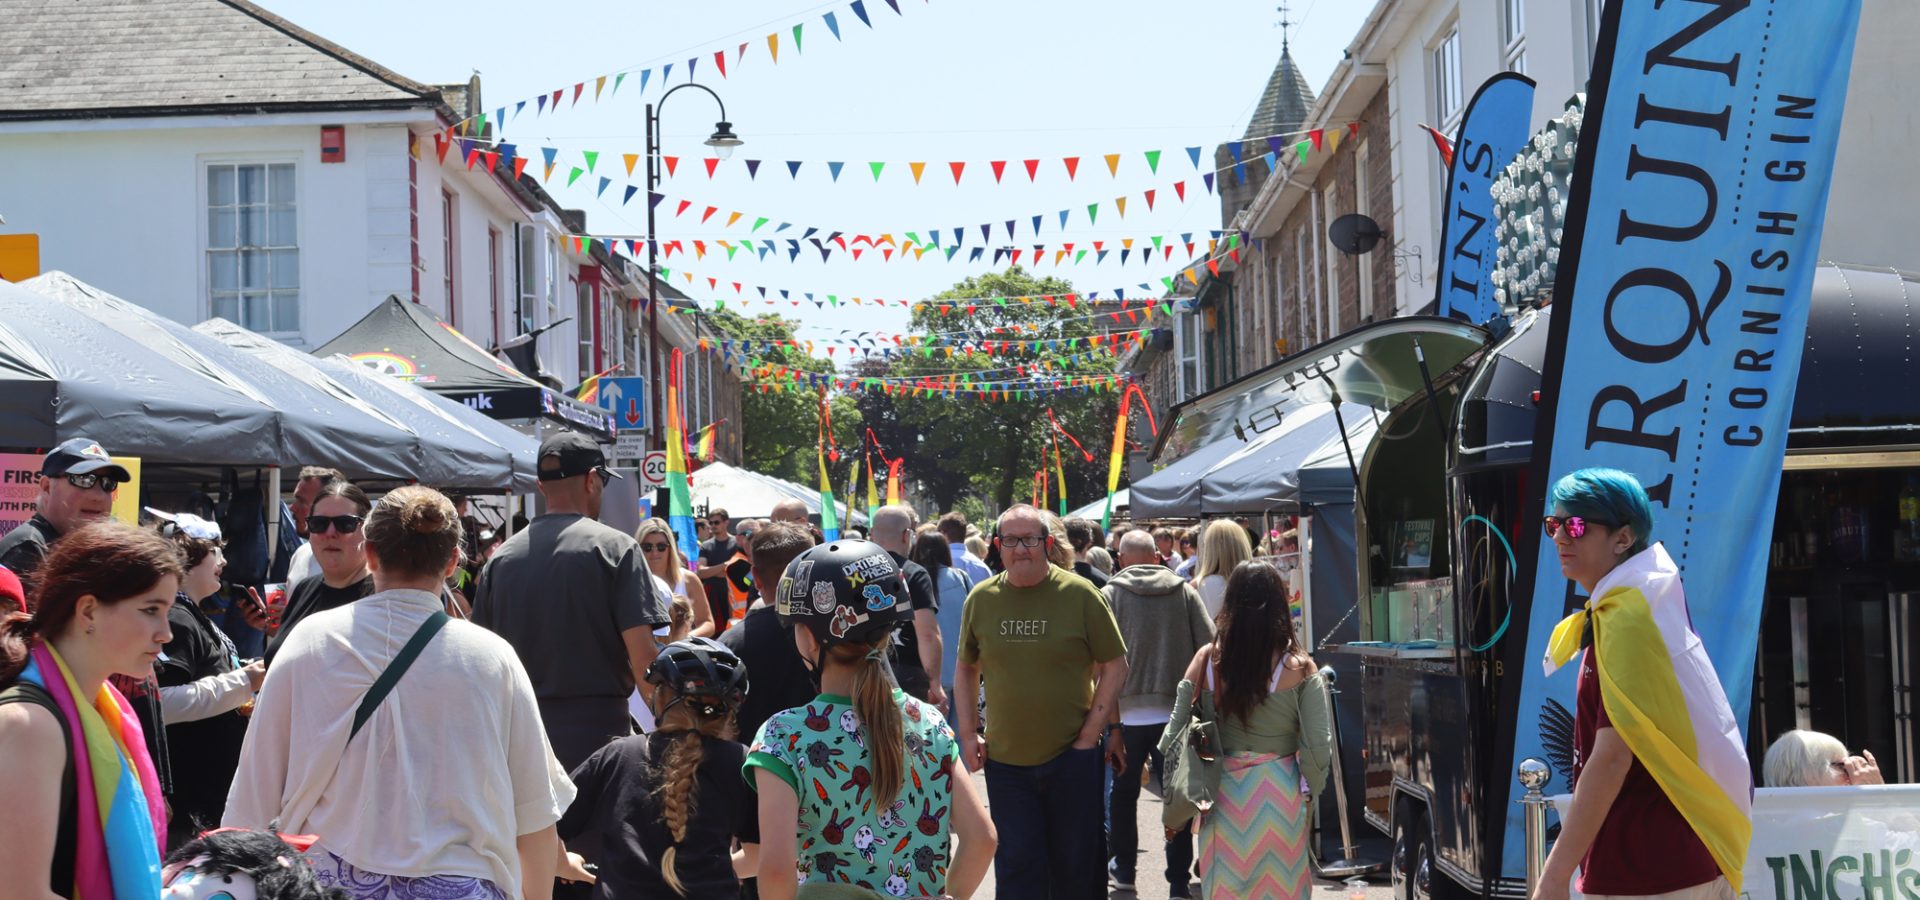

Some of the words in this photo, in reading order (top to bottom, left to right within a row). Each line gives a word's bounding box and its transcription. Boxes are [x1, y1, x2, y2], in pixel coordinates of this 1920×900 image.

[1765, 95, 1816, 182] GIN
[1562, 0, 1751, 620] RQUIN
[1723, 211, 1798, 447] CORNISH
[647, 462, 666, 474] 20
[1404, 520, 1431, 531] FESTIVAL
[1414, 532, 1430, 542] CUPS
[842, 554, 889, 576] DIRTBIKE
[1000, 620, 1048, 635] STREET
